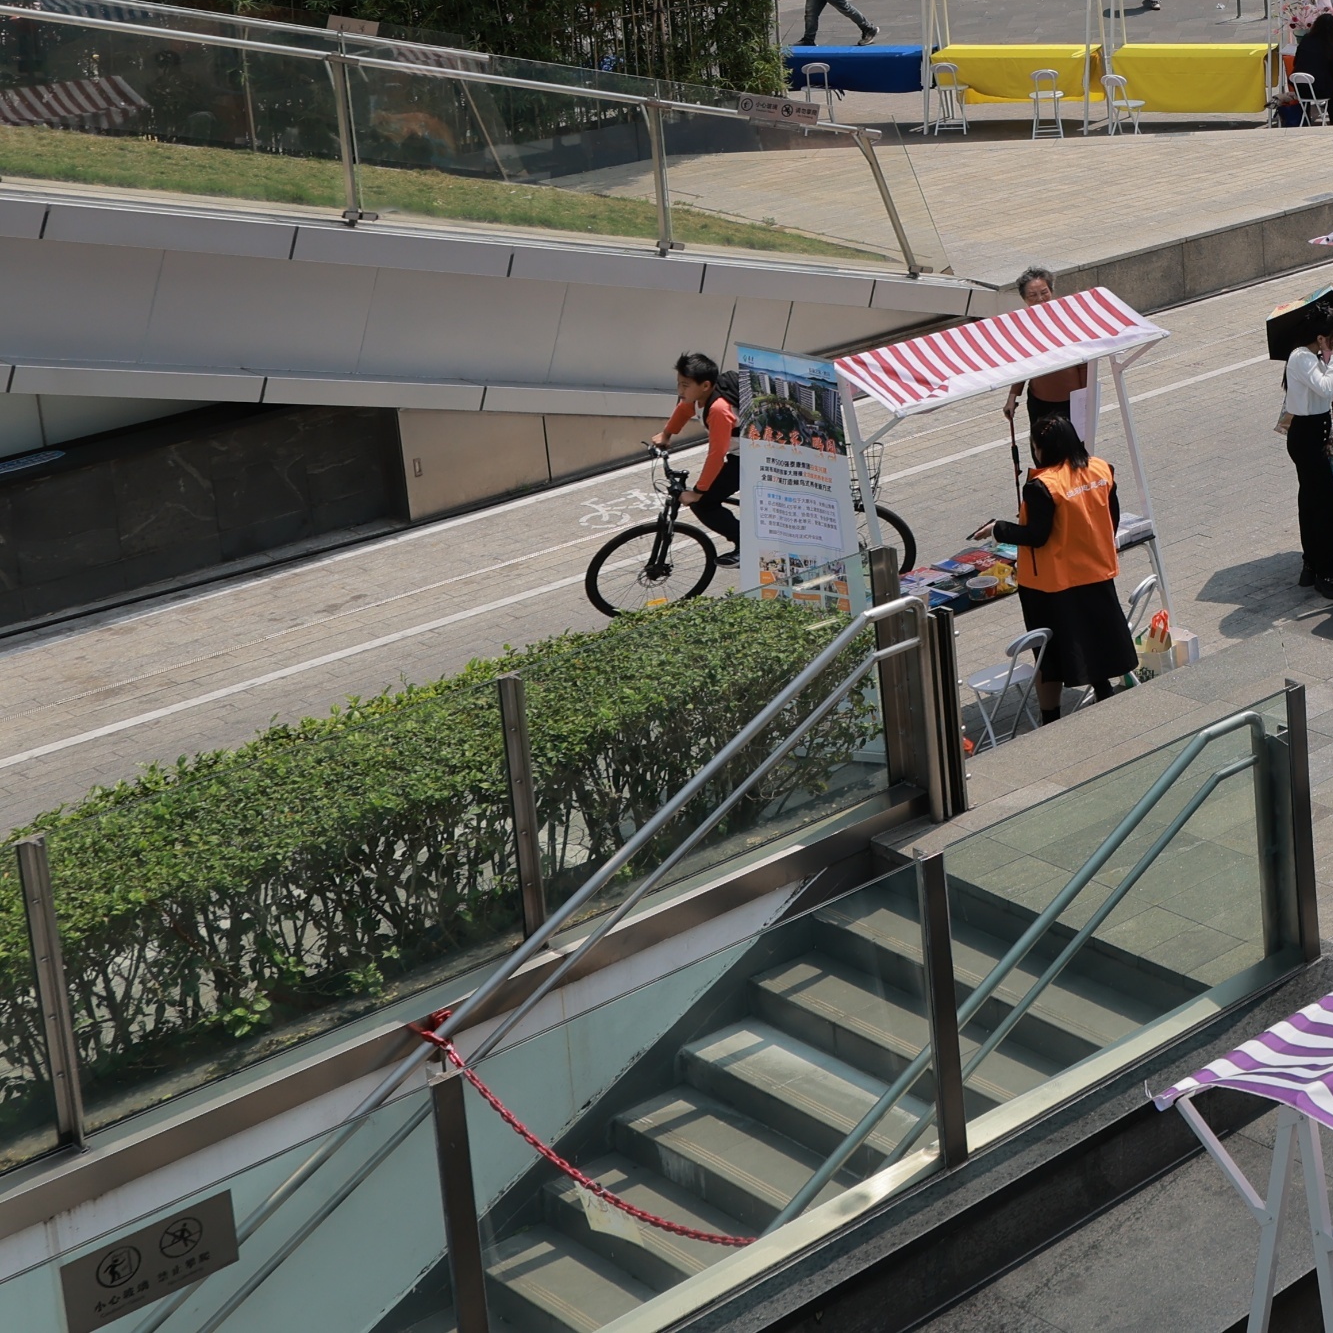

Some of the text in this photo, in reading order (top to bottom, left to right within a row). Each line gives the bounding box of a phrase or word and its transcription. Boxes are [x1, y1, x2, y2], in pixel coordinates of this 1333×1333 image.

[755, 101, 778, 112] 小心玻璃
[795, 106, 819, 117] 请勿攀爬
[94, 1279, 150, 1314] 小心玻璃
